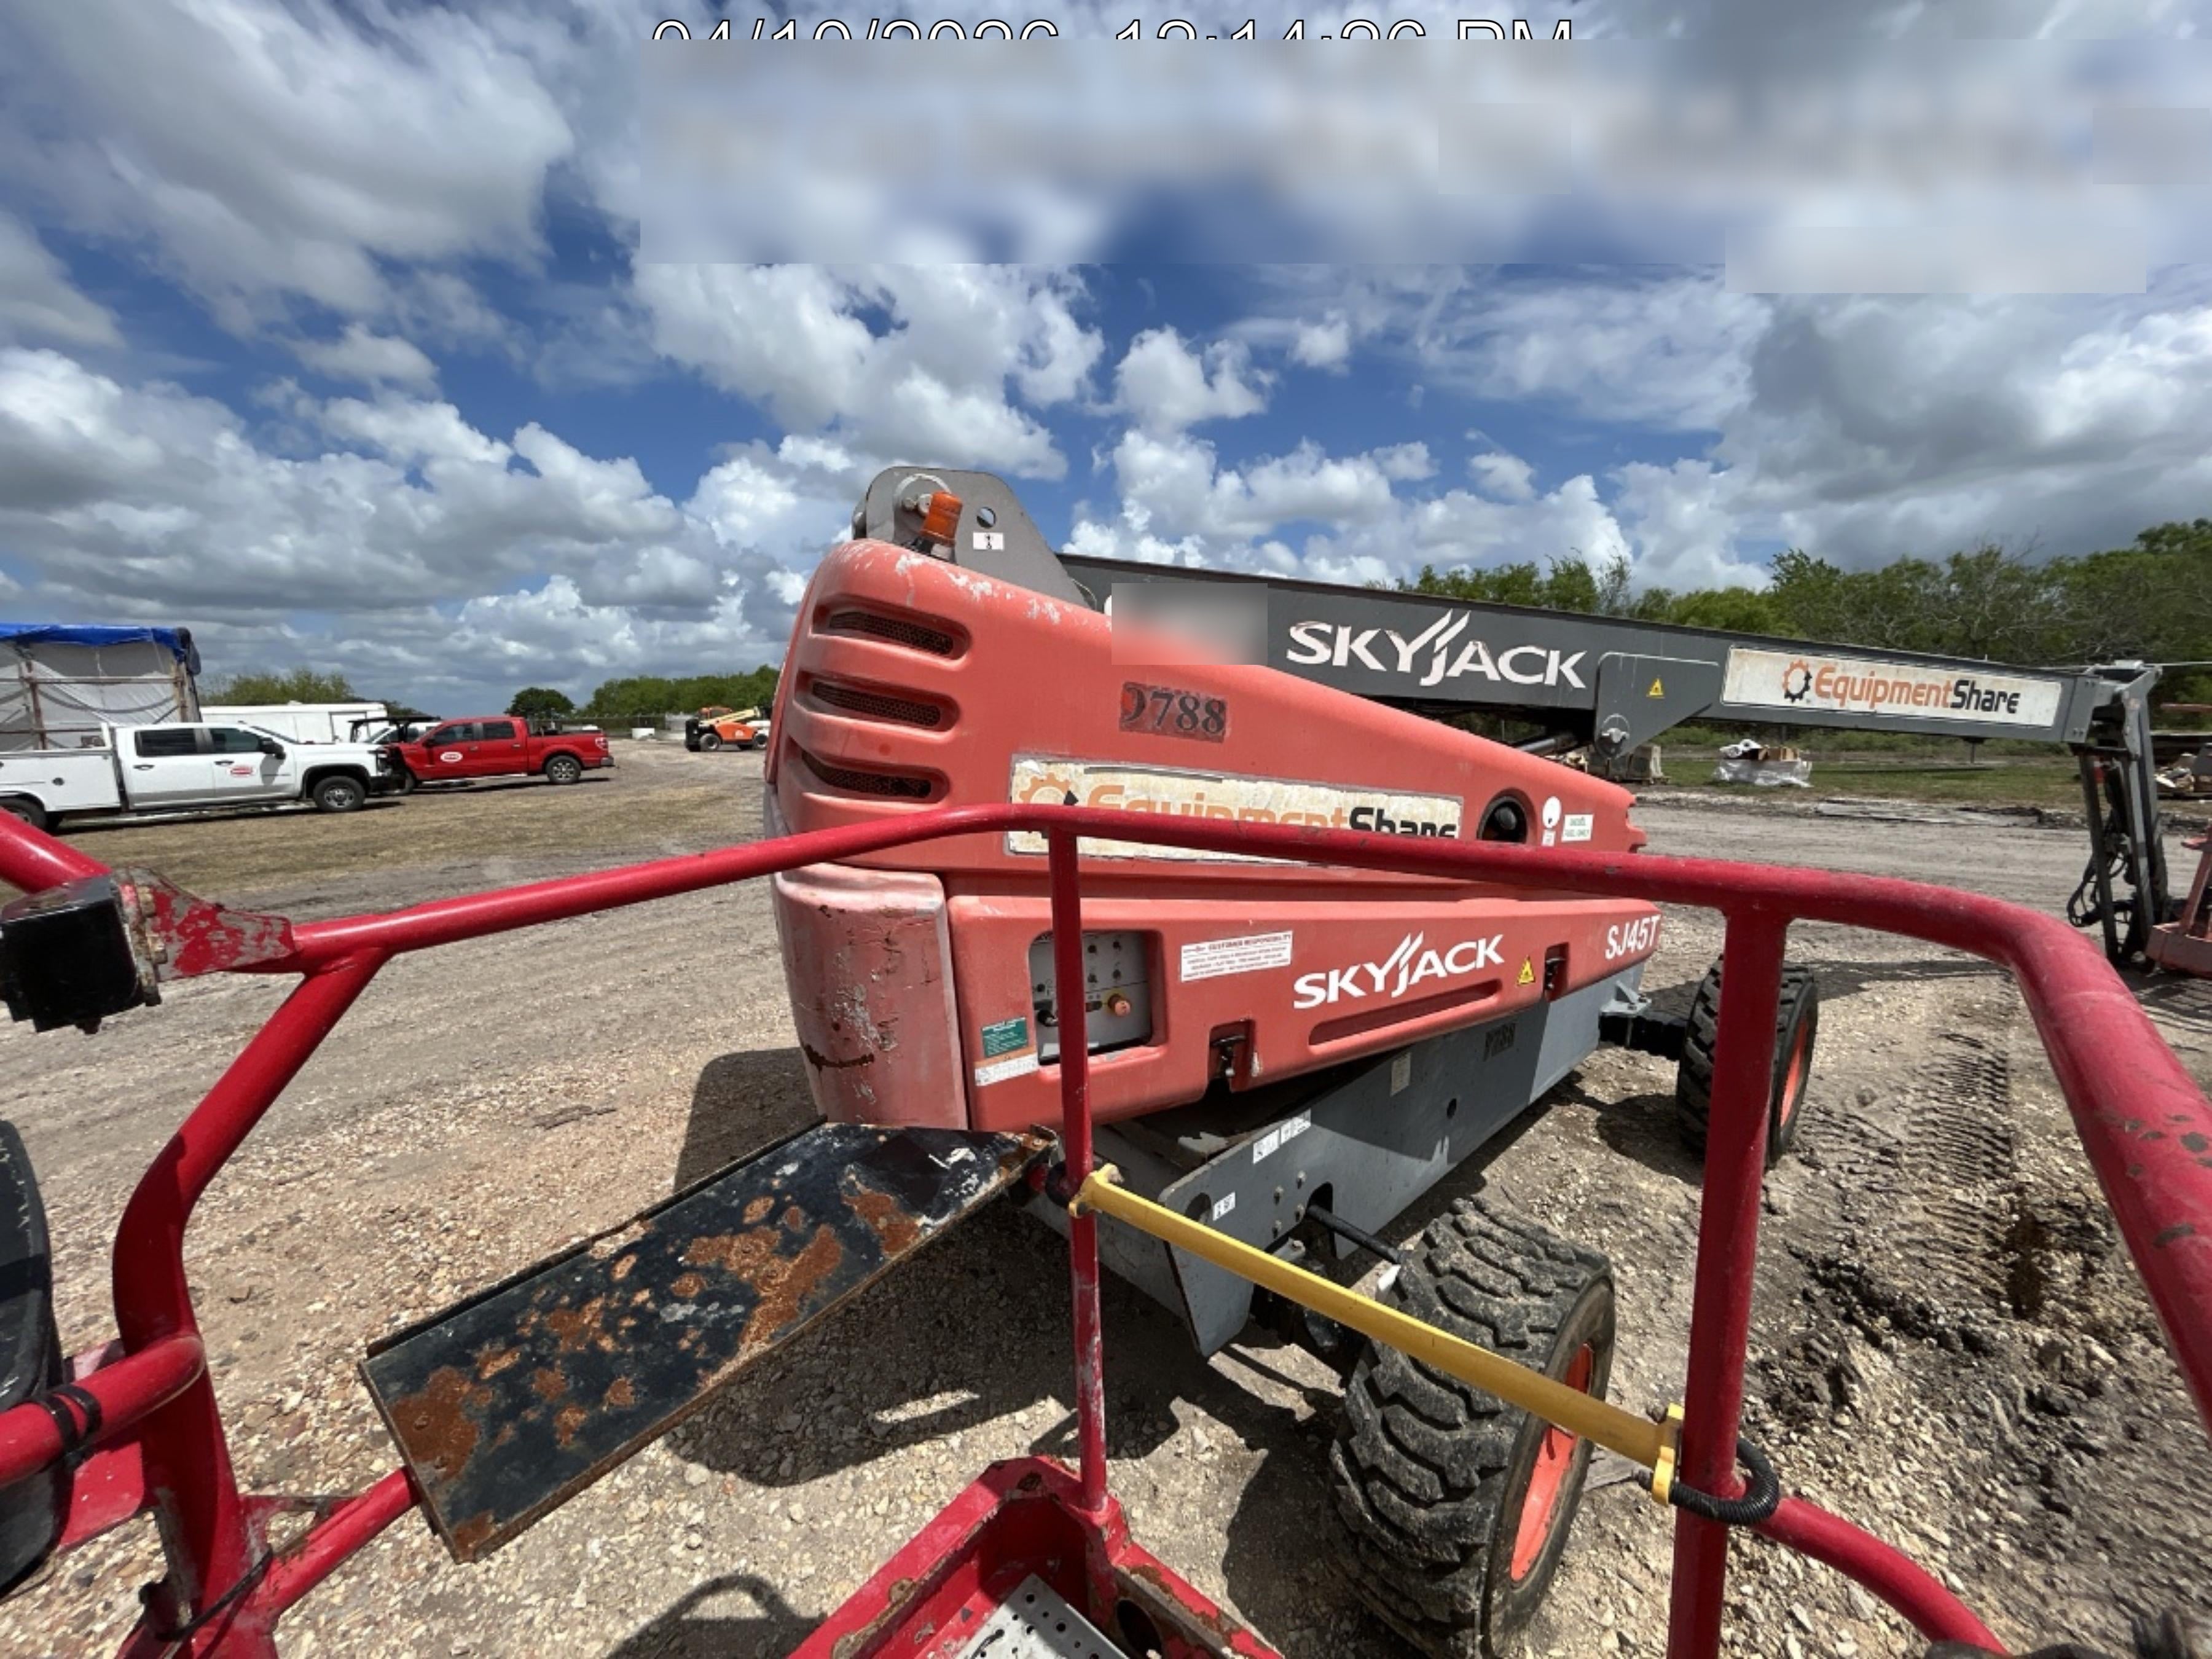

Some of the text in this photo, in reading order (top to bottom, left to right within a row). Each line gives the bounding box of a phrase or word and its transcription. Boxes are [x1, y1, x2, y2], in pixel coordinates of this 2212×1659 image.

[1287, 608, 1587, 688] SKYJACK
[1814, 665, 2021, 714] EquipmentShare
[1605, 914, 1661, 959] SJ45T
[1293, 930, 1505, 1009] SKYJACK
